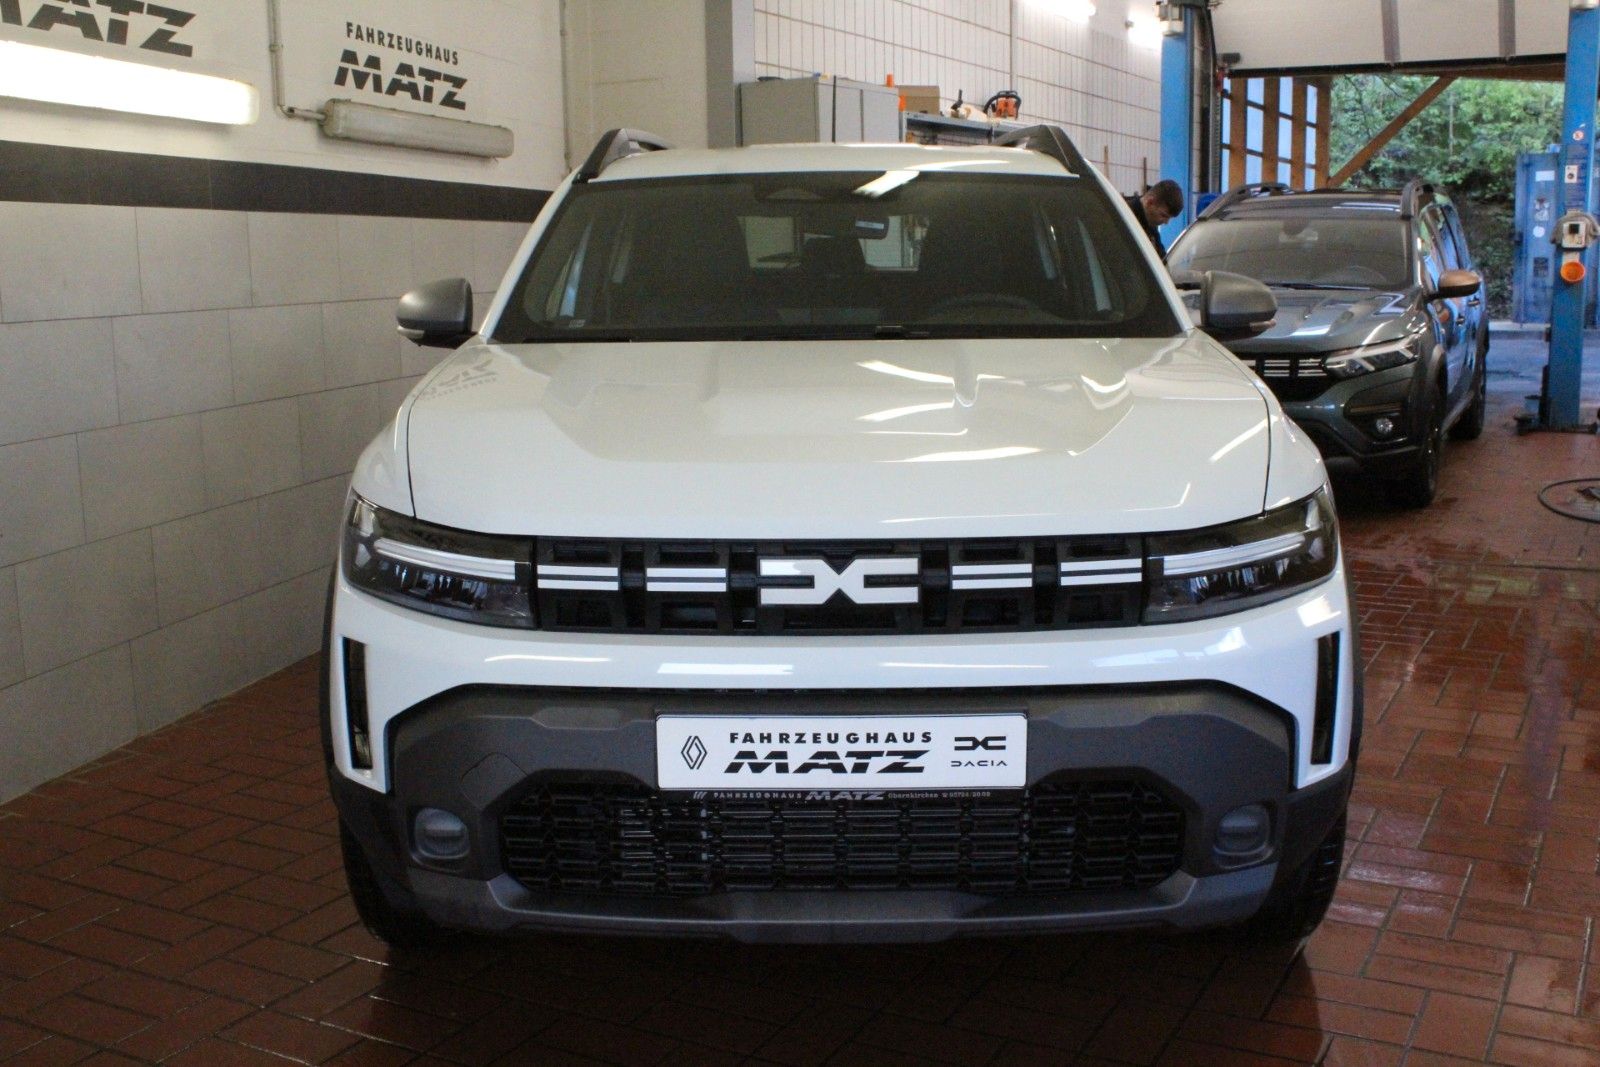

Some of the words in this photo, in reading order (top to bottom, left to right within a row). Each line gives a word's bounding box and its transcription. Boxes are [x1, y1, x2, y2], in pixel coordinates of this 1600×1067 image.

[0, 0, 196, 57] ATZ
[346, 21, 459, 65] FAHRZEUGHAUS
[334, 48, 468, 110] MATZ
[729, 731, 932, 744] FAHRZEUGHAUS
[723, 750, 930, 774] MATZ
[950, 759, 1008, 767] DACIA
[713, 791, 803, 799] FAHRZEUGHAUS
[804, 790, 885, 801] MATZ
